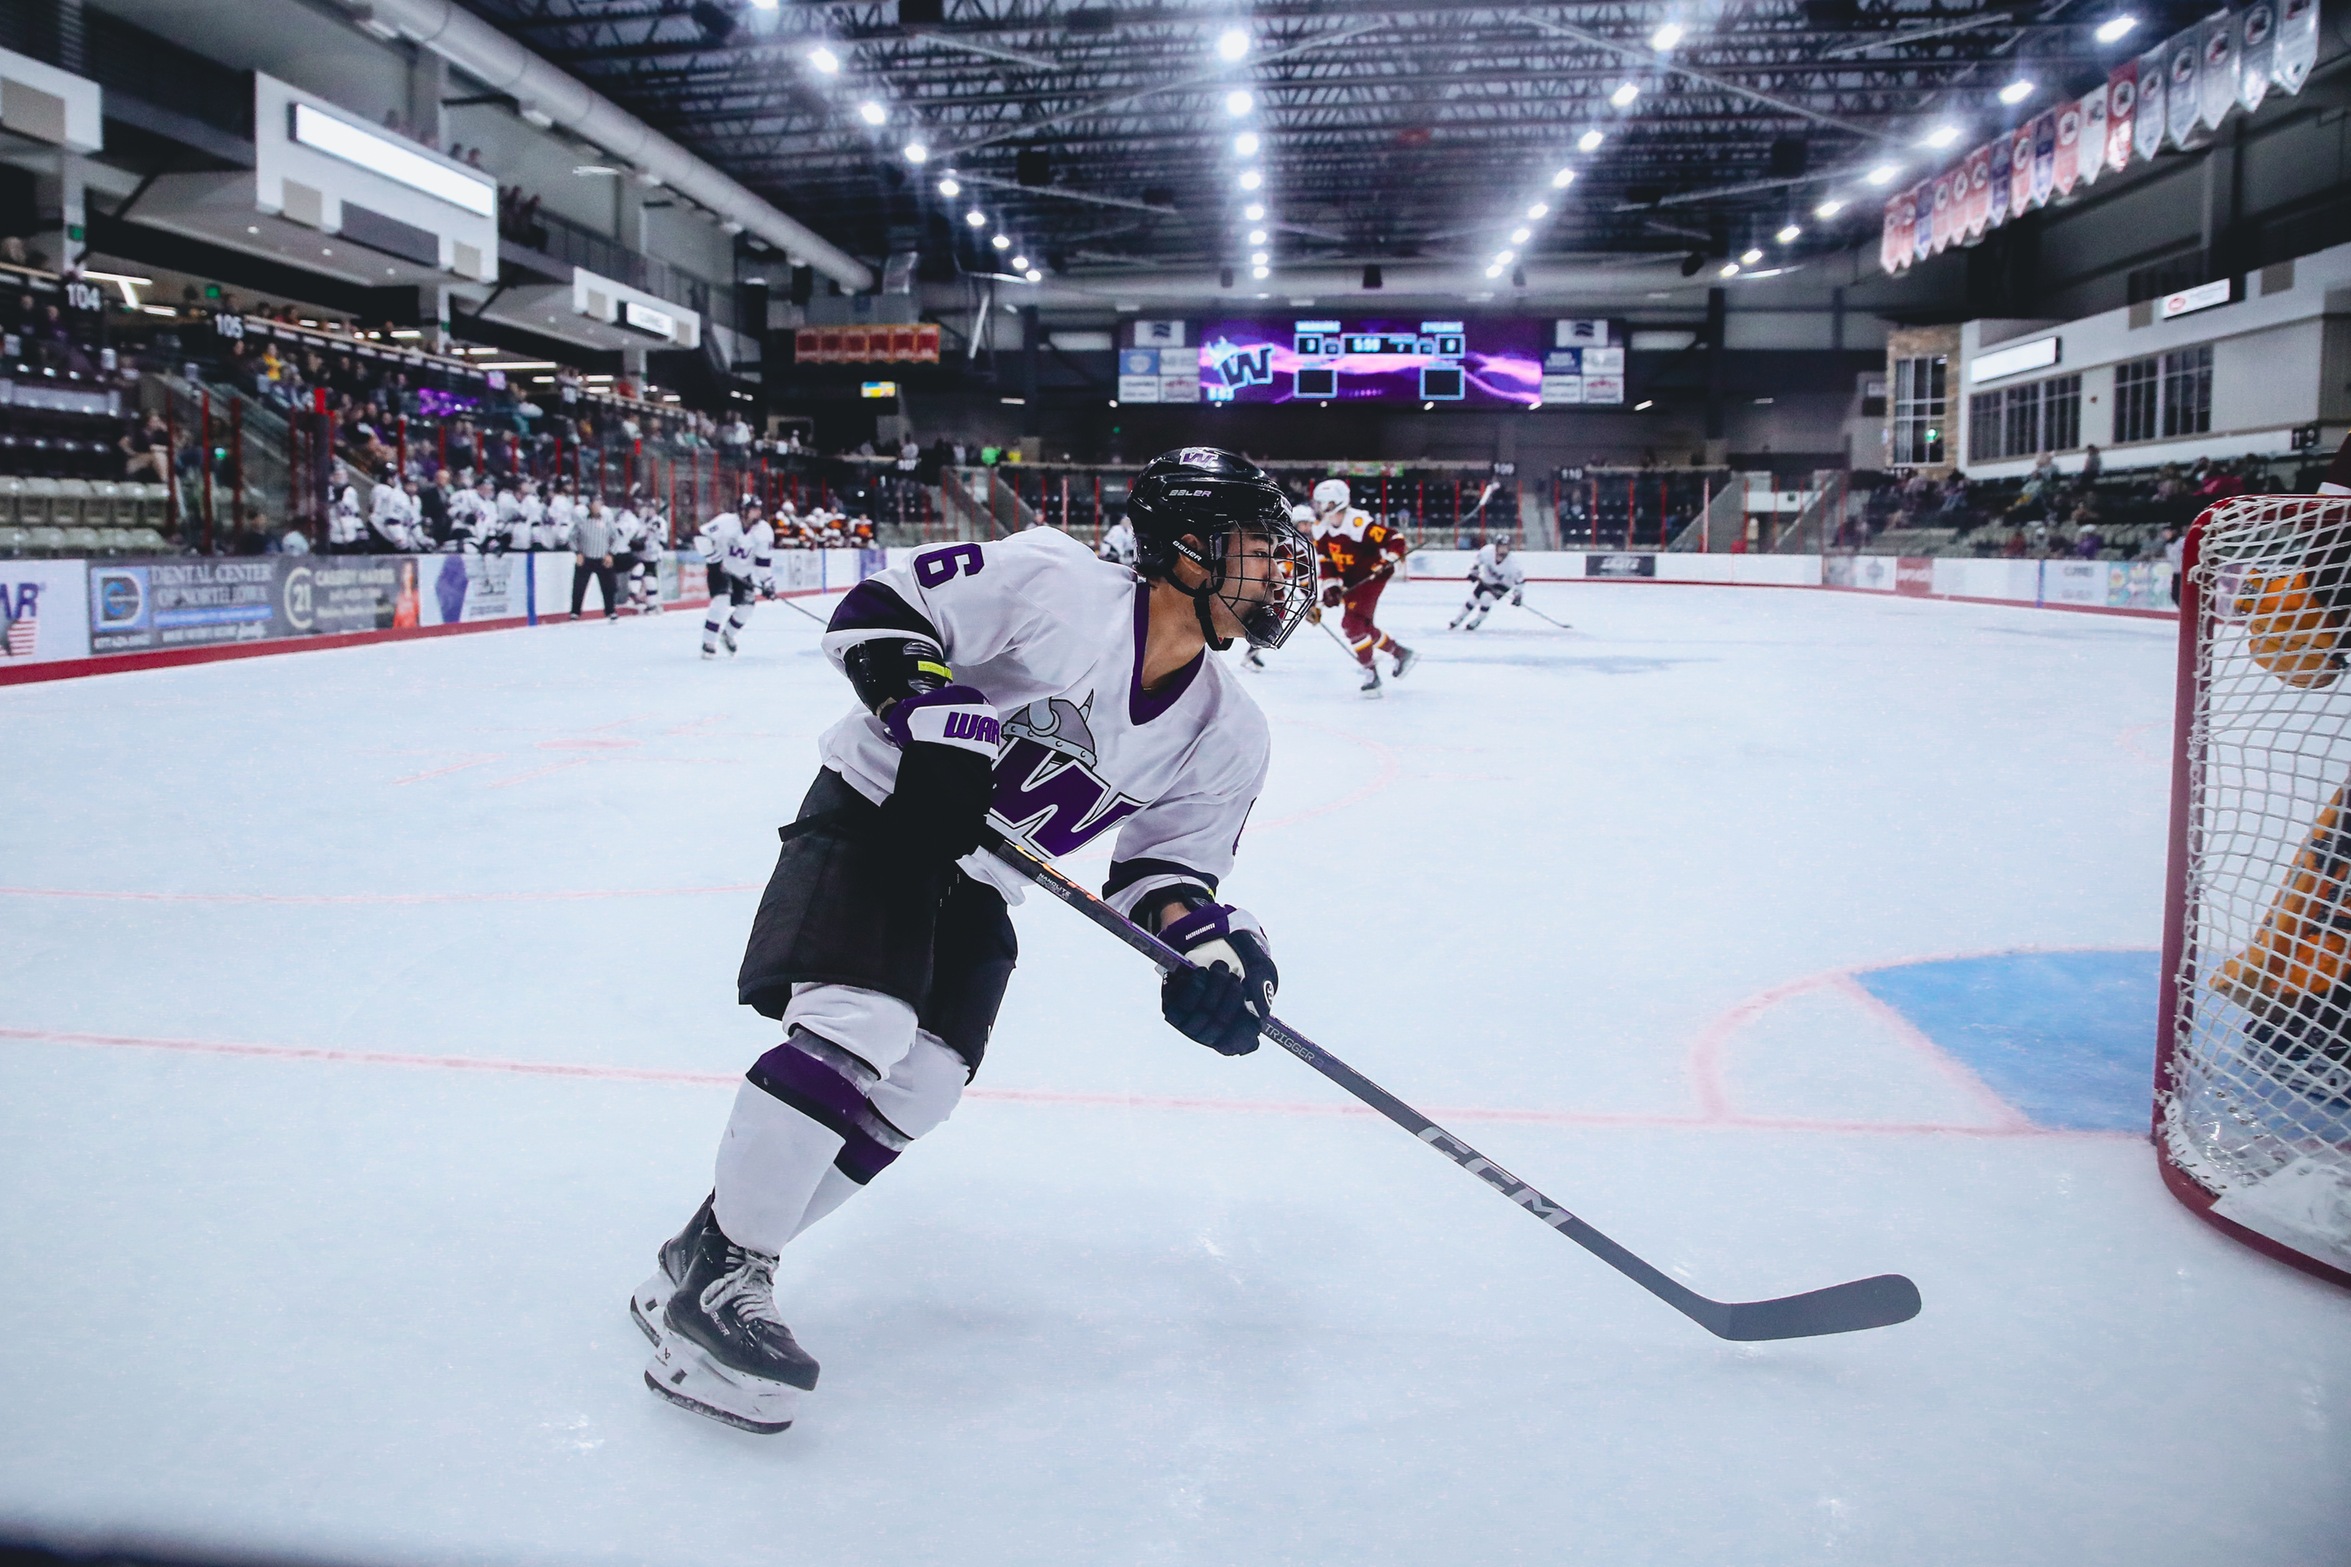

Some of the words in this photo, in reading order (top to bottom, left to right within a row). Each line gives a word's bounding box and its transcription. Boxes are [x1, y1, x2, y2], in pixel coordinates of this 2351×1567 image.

[66, 283, 101, 312] 104
[1172, 540, 1202, 562] BAUER
[151, 565, 213, 585] DENTAL
[215, 563, 273, 583] CENTER
[1265, 1023, 1315, 1061] TRIGGER
[1417, 1125, 1574, 1228] CCM
[710, 1311, 730, 1336] AUER
